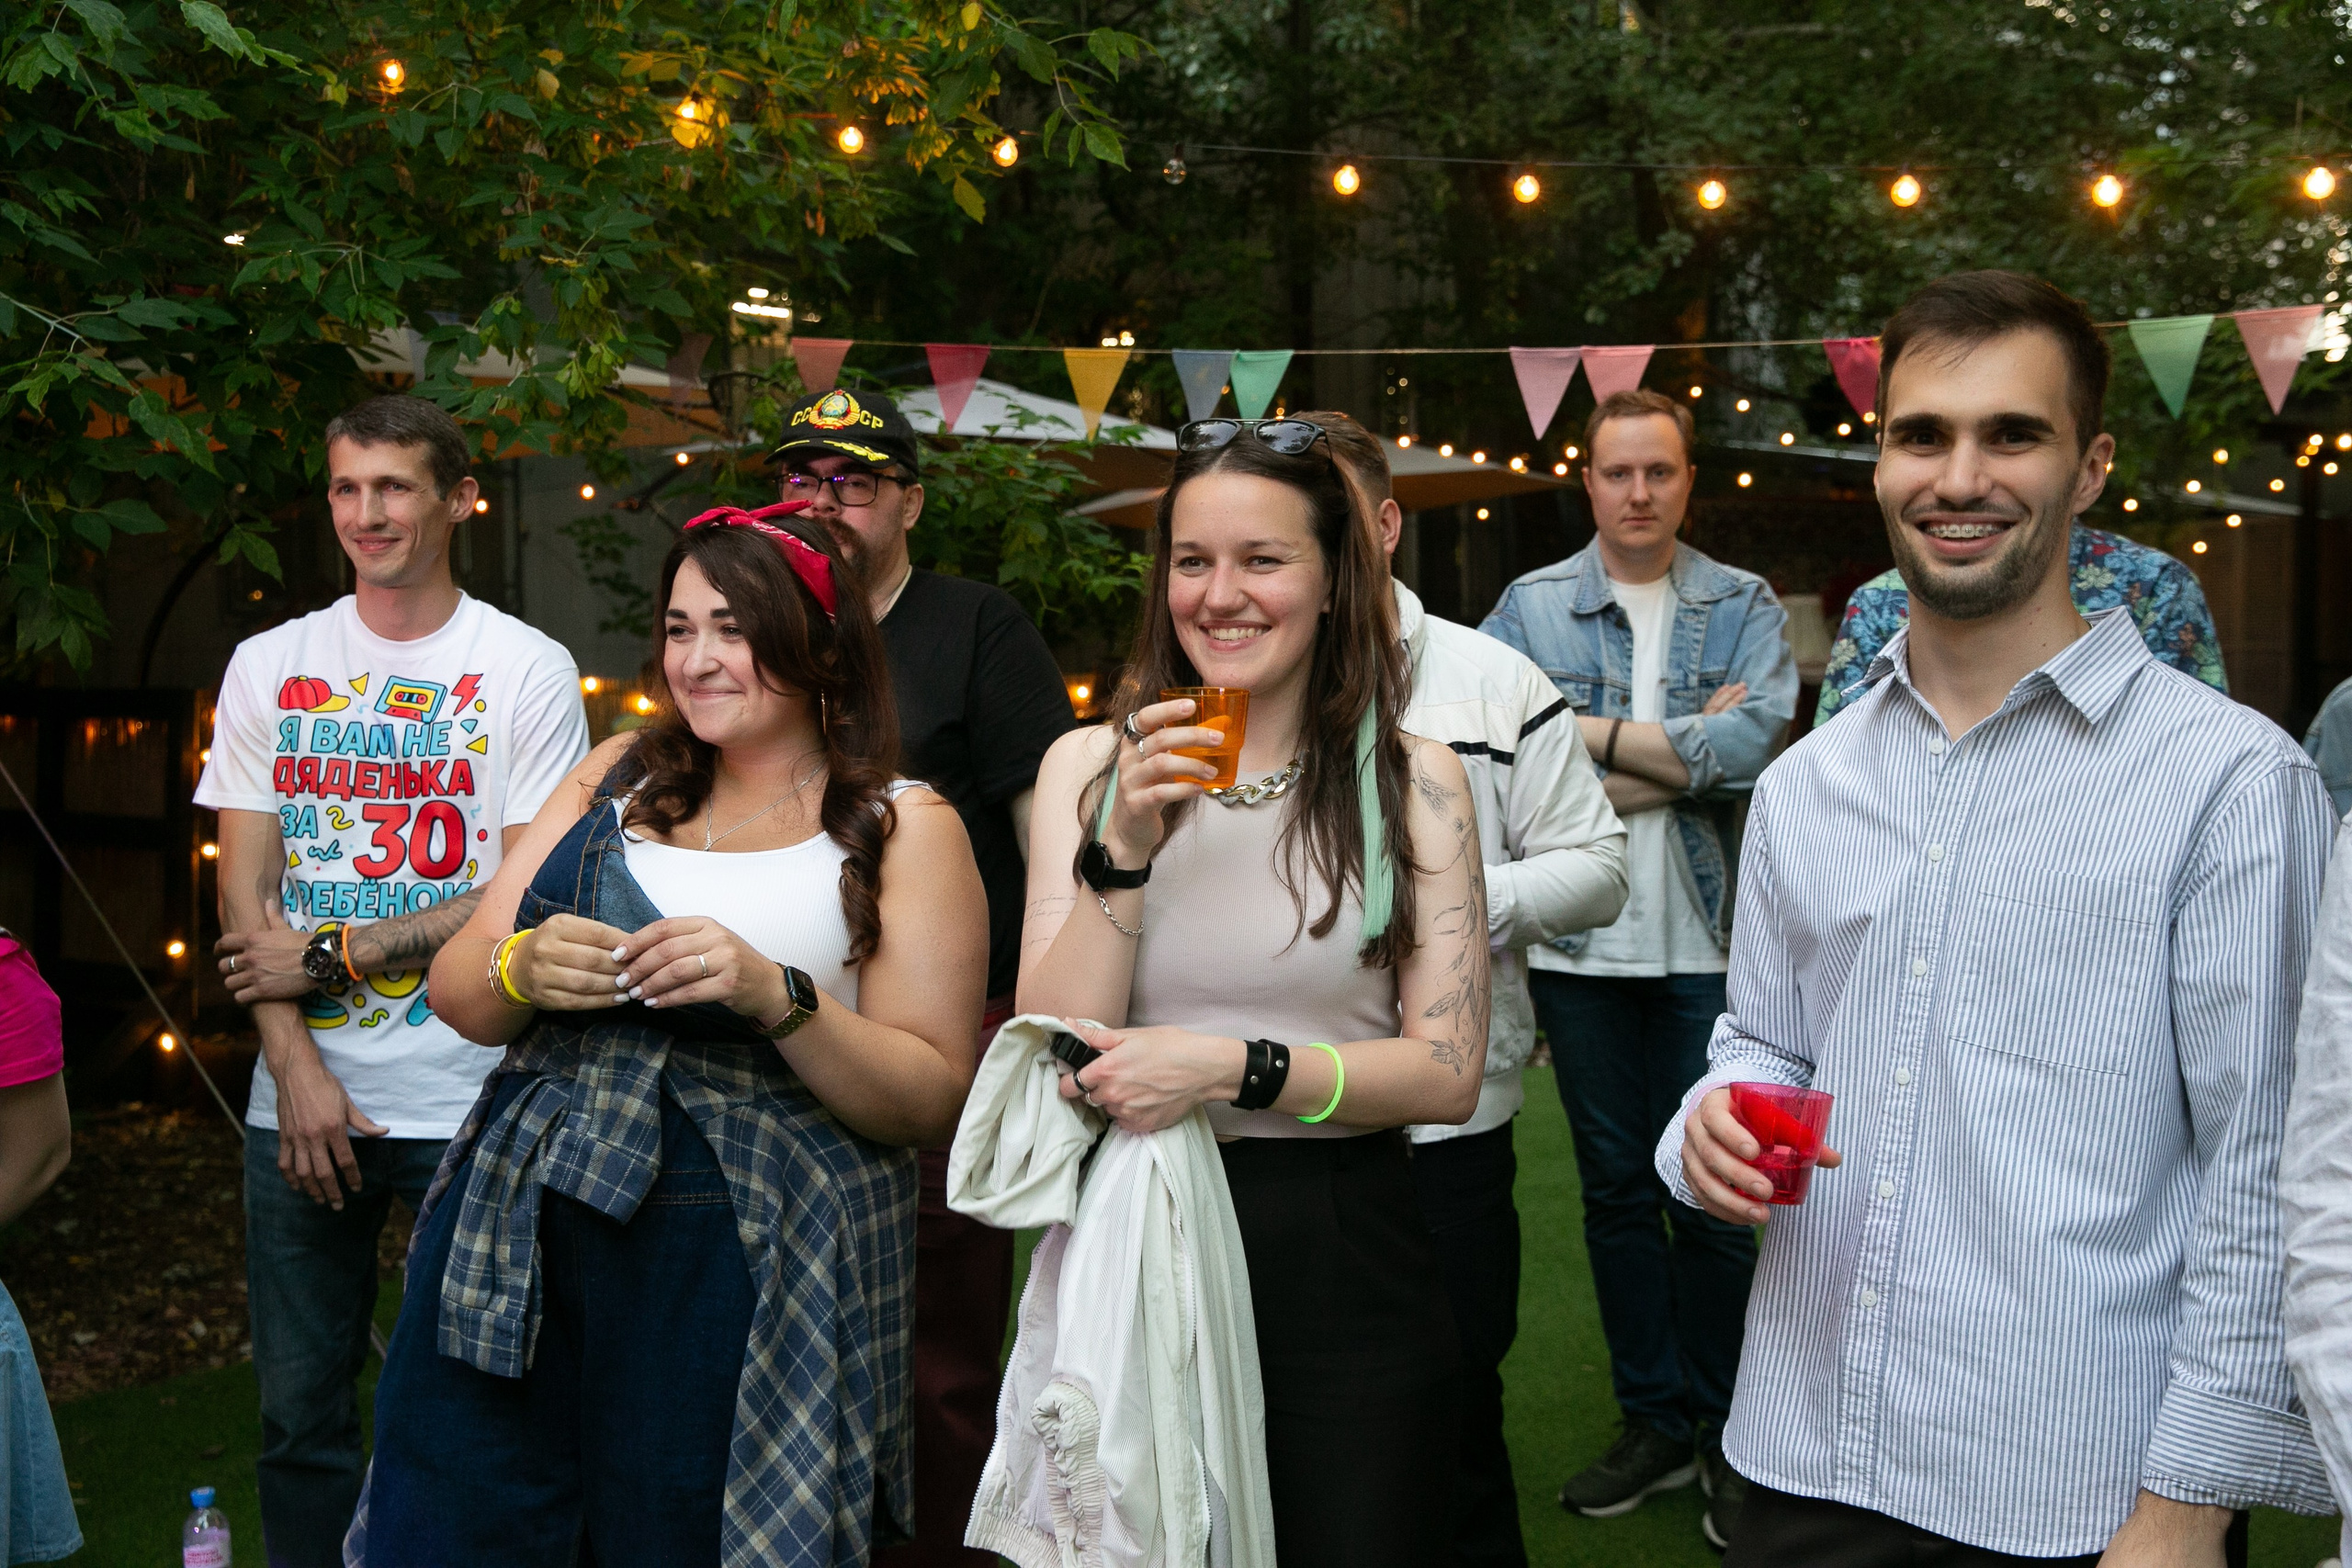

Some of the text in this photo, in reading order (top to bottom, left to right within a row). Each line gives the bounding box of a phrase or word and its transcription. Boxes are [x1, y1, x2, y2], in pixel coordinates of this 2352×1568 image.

[277, 716, 452, 759] Я ВАМ НЕ
[273, 756, 475, 802] ДЯДЕНЬКА
[280, 800, 467, 880] ЗА 30
